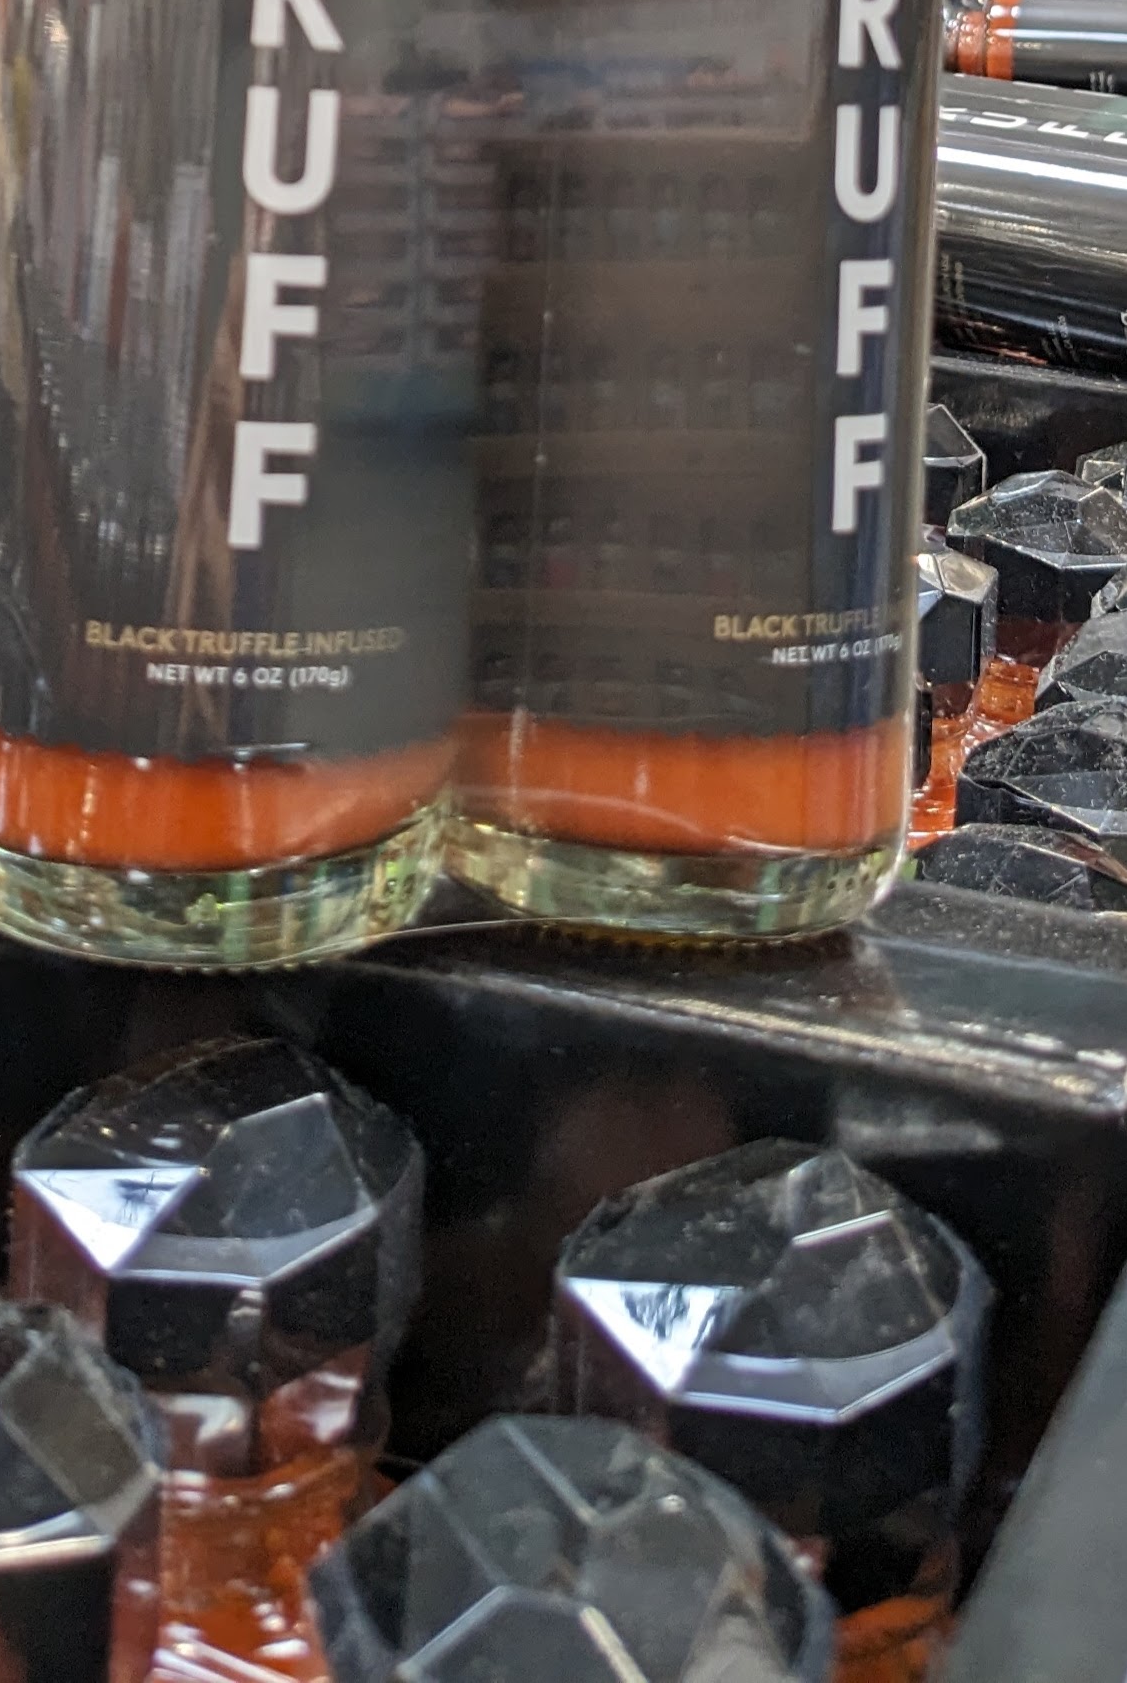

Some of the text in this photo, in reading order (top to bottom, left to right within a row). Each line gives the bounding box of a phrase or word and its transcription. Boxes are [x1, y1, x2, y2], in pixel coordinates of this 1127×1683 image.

[85, 619, 178, 653] BLACK
[712, 614, 798, 641] BLACK
[772, 645, 810, 665] NET
[811, 643, 838, 661] WT
[839, 641, 849, 660] 6
[852, 638, 871, 656] OZ
[146, 662, 350, 690] NET WT 6 OZ (170g)
